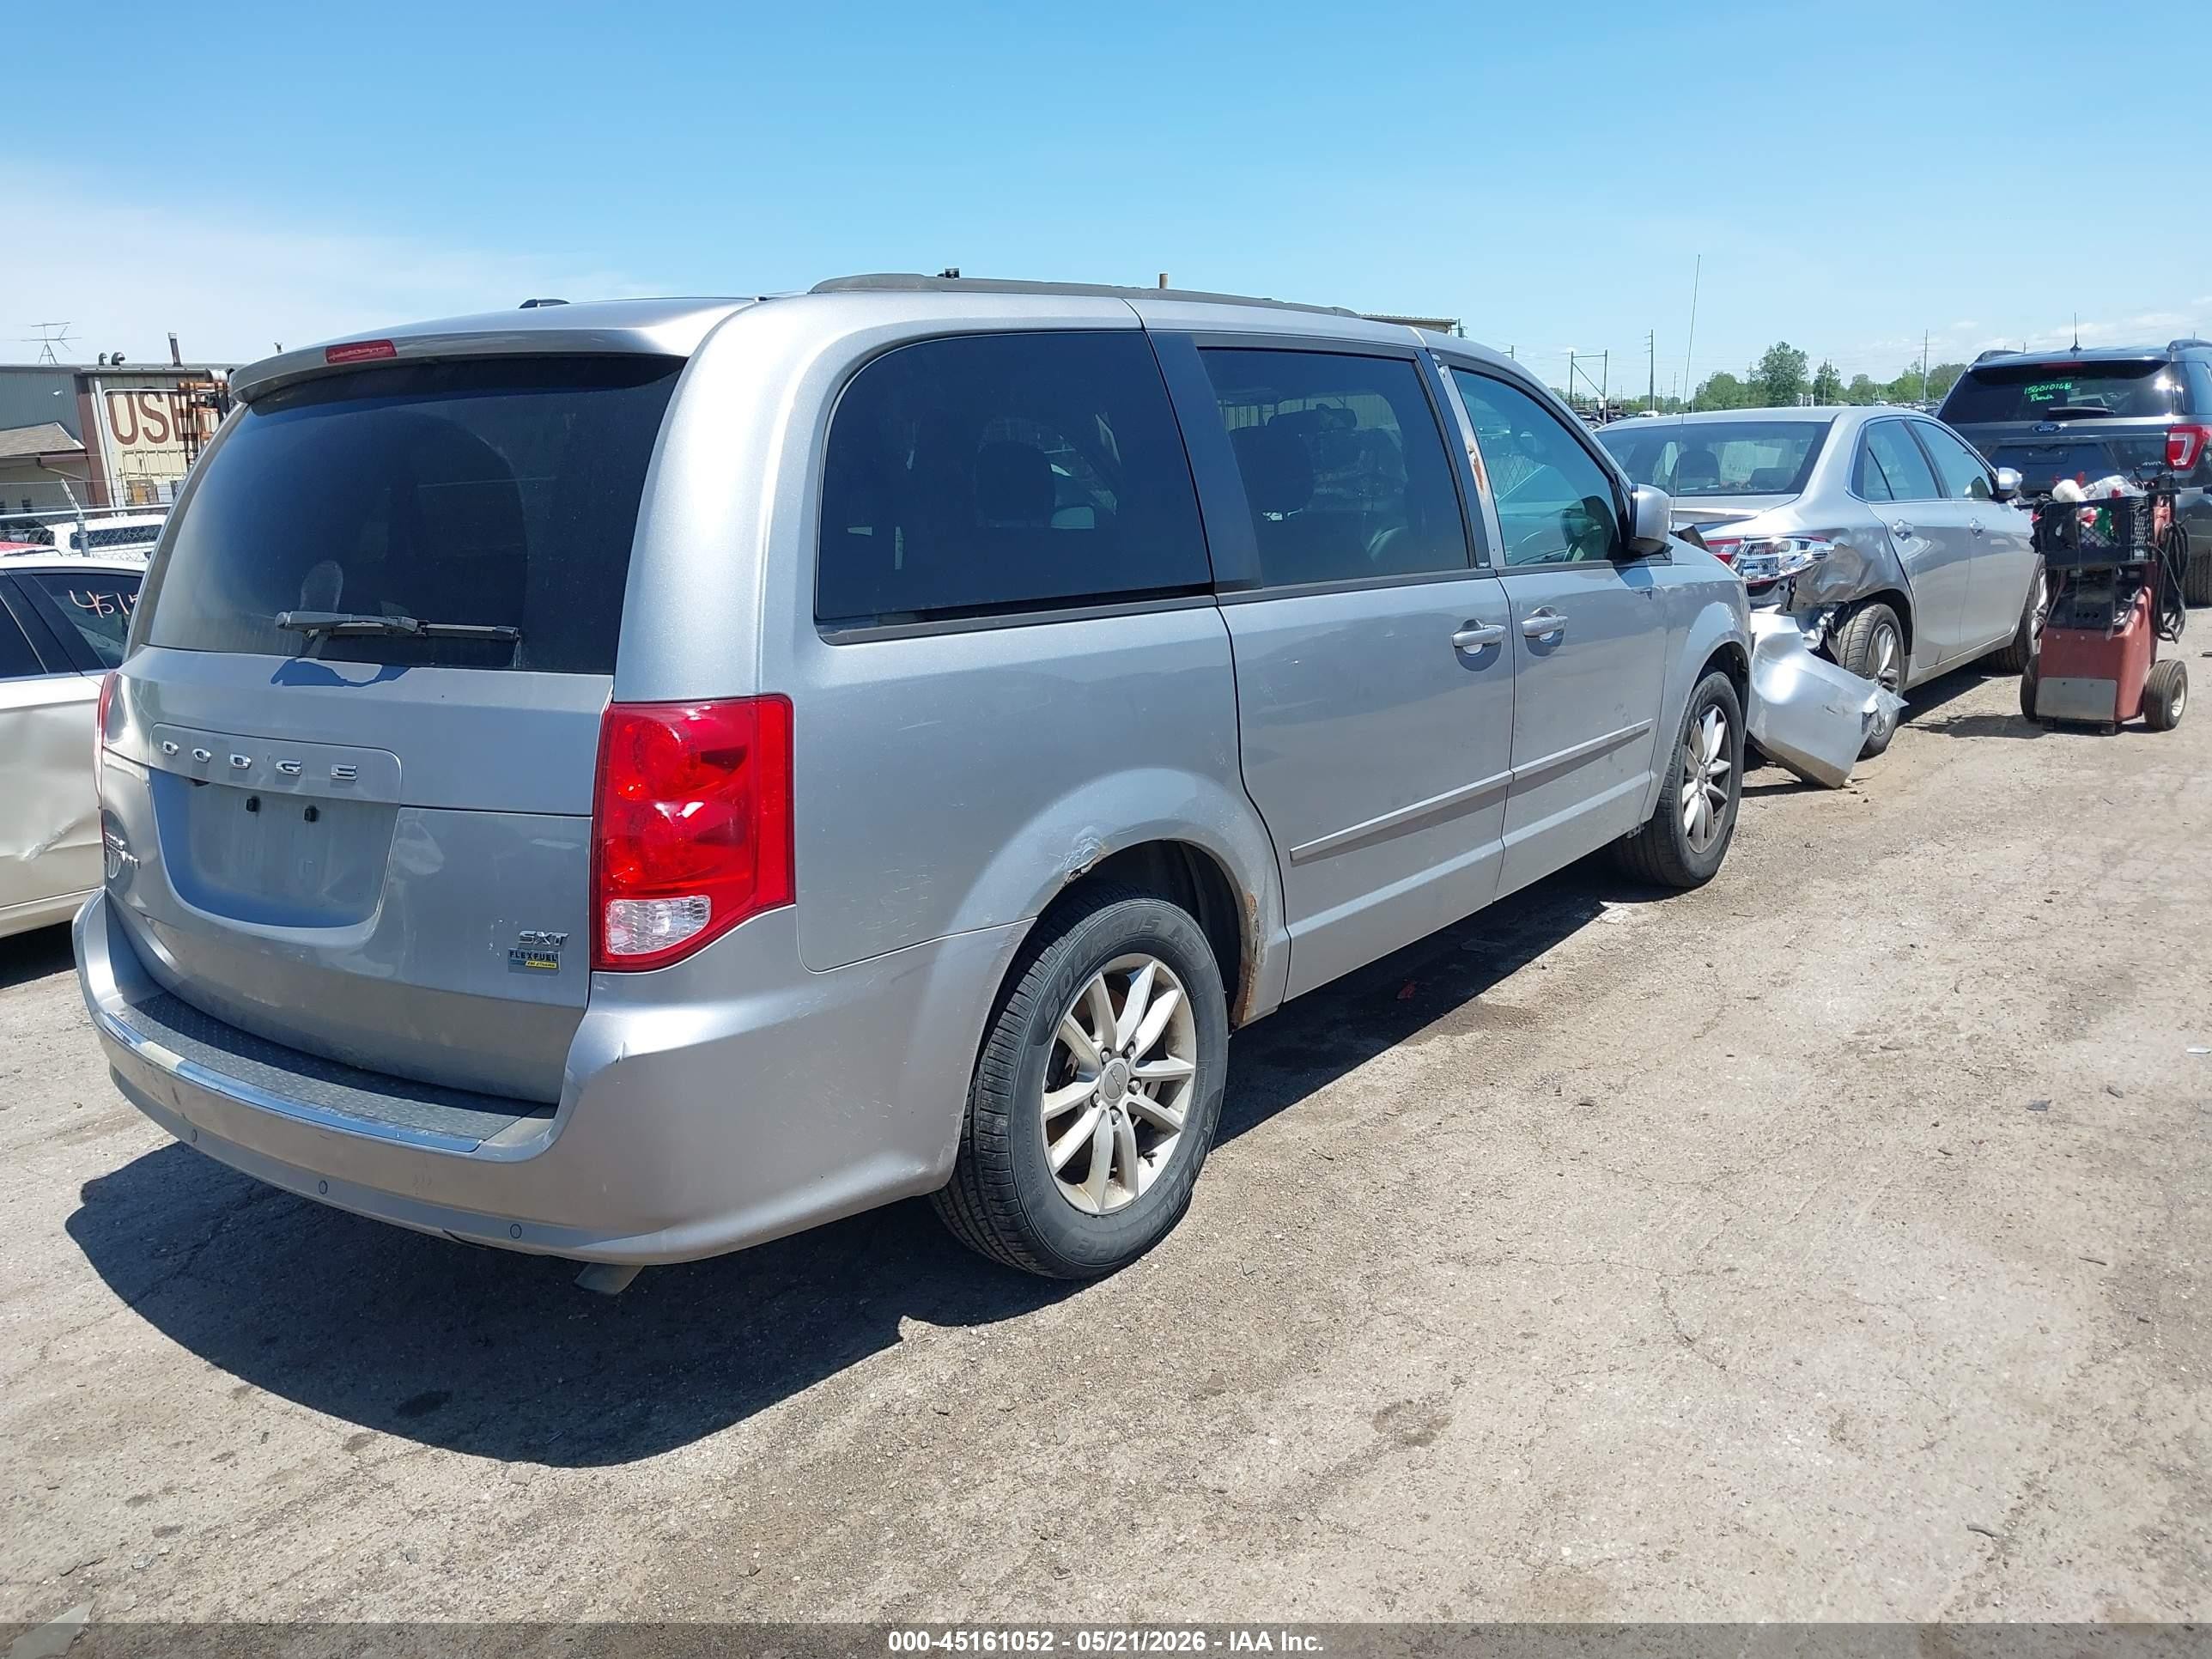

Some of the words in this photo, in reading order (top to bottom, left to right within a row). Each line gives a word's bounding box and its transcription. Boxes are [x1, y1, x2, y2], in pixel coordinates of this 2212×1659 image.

[106, 387, 210, 446] USE
[161, 739, 358, 781] DODGE
[520, 930, 568, 945] SXT
[1045, 915, 1162, 1032] SOLARUS
